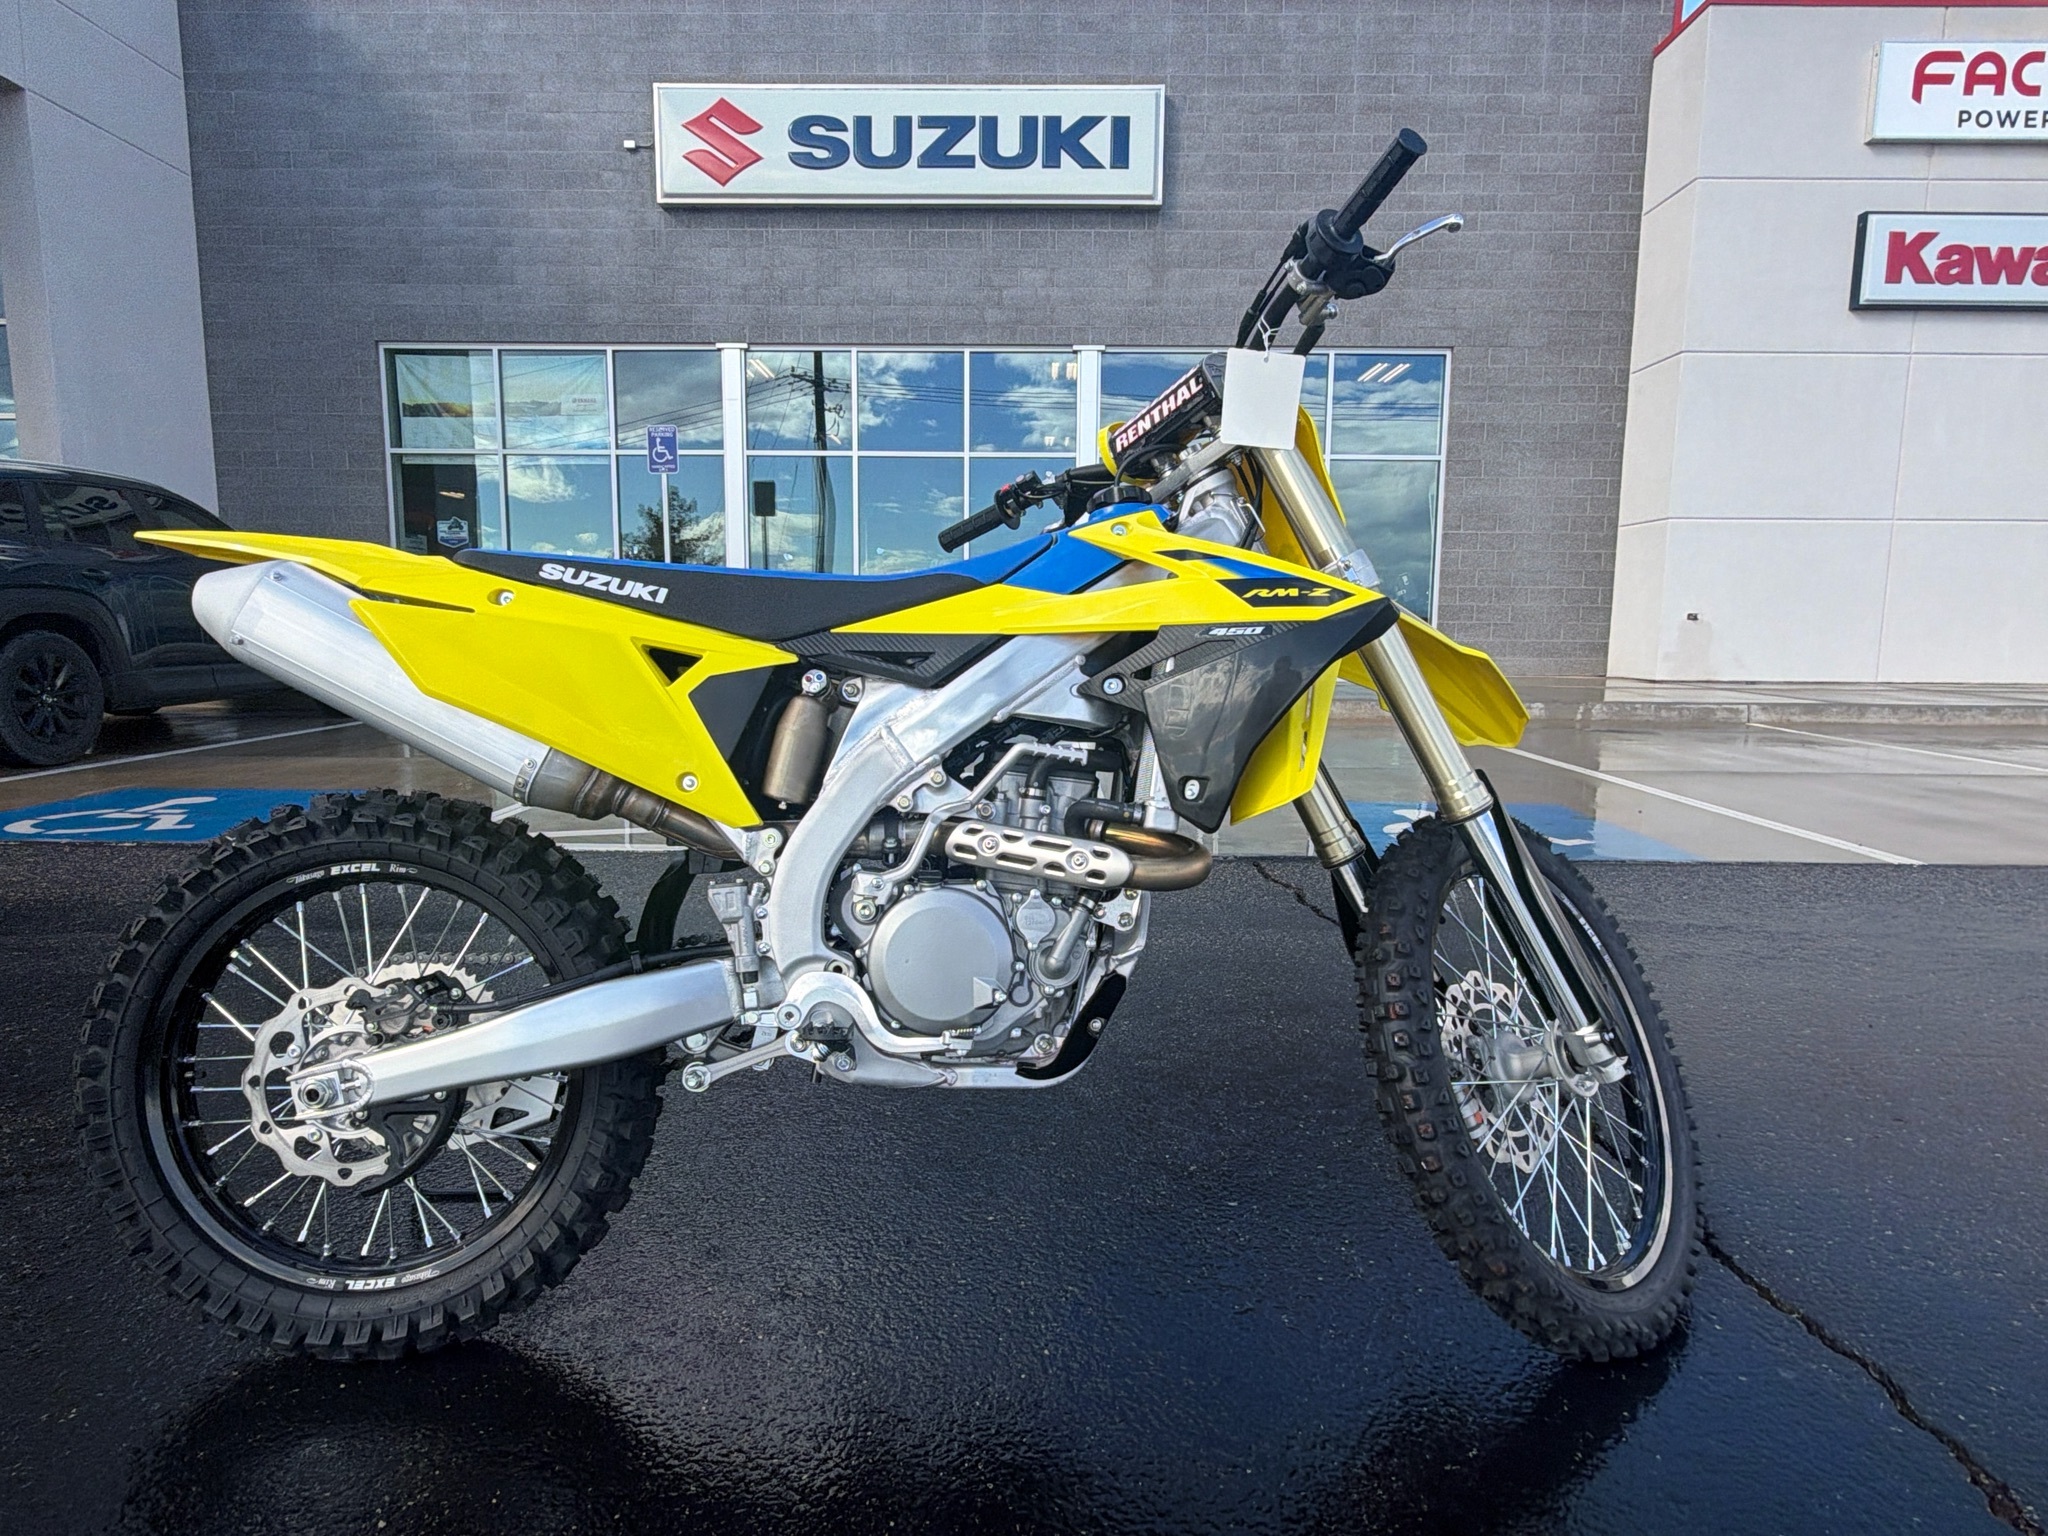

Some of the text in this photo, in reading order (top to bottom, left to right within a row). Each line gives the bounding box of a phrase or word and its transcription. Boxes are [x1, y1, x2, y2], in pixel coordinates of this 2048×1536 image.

[1911, 51, 2046, 104] FAC
[787, 114, 1130, 171] SUZUKI
[1115, 377, 1203, 453] RENTHAL
[538, 562, 669, 605] SUZUKI
[1241, 587, 1333, 599] RM-Z
[1207, 626, 1267, 637] 450
[329, 862, 381, 876] EXCEL
[388, 862, 407, 874] Rim
[345, 1276, 397, 1291] EXCEL
